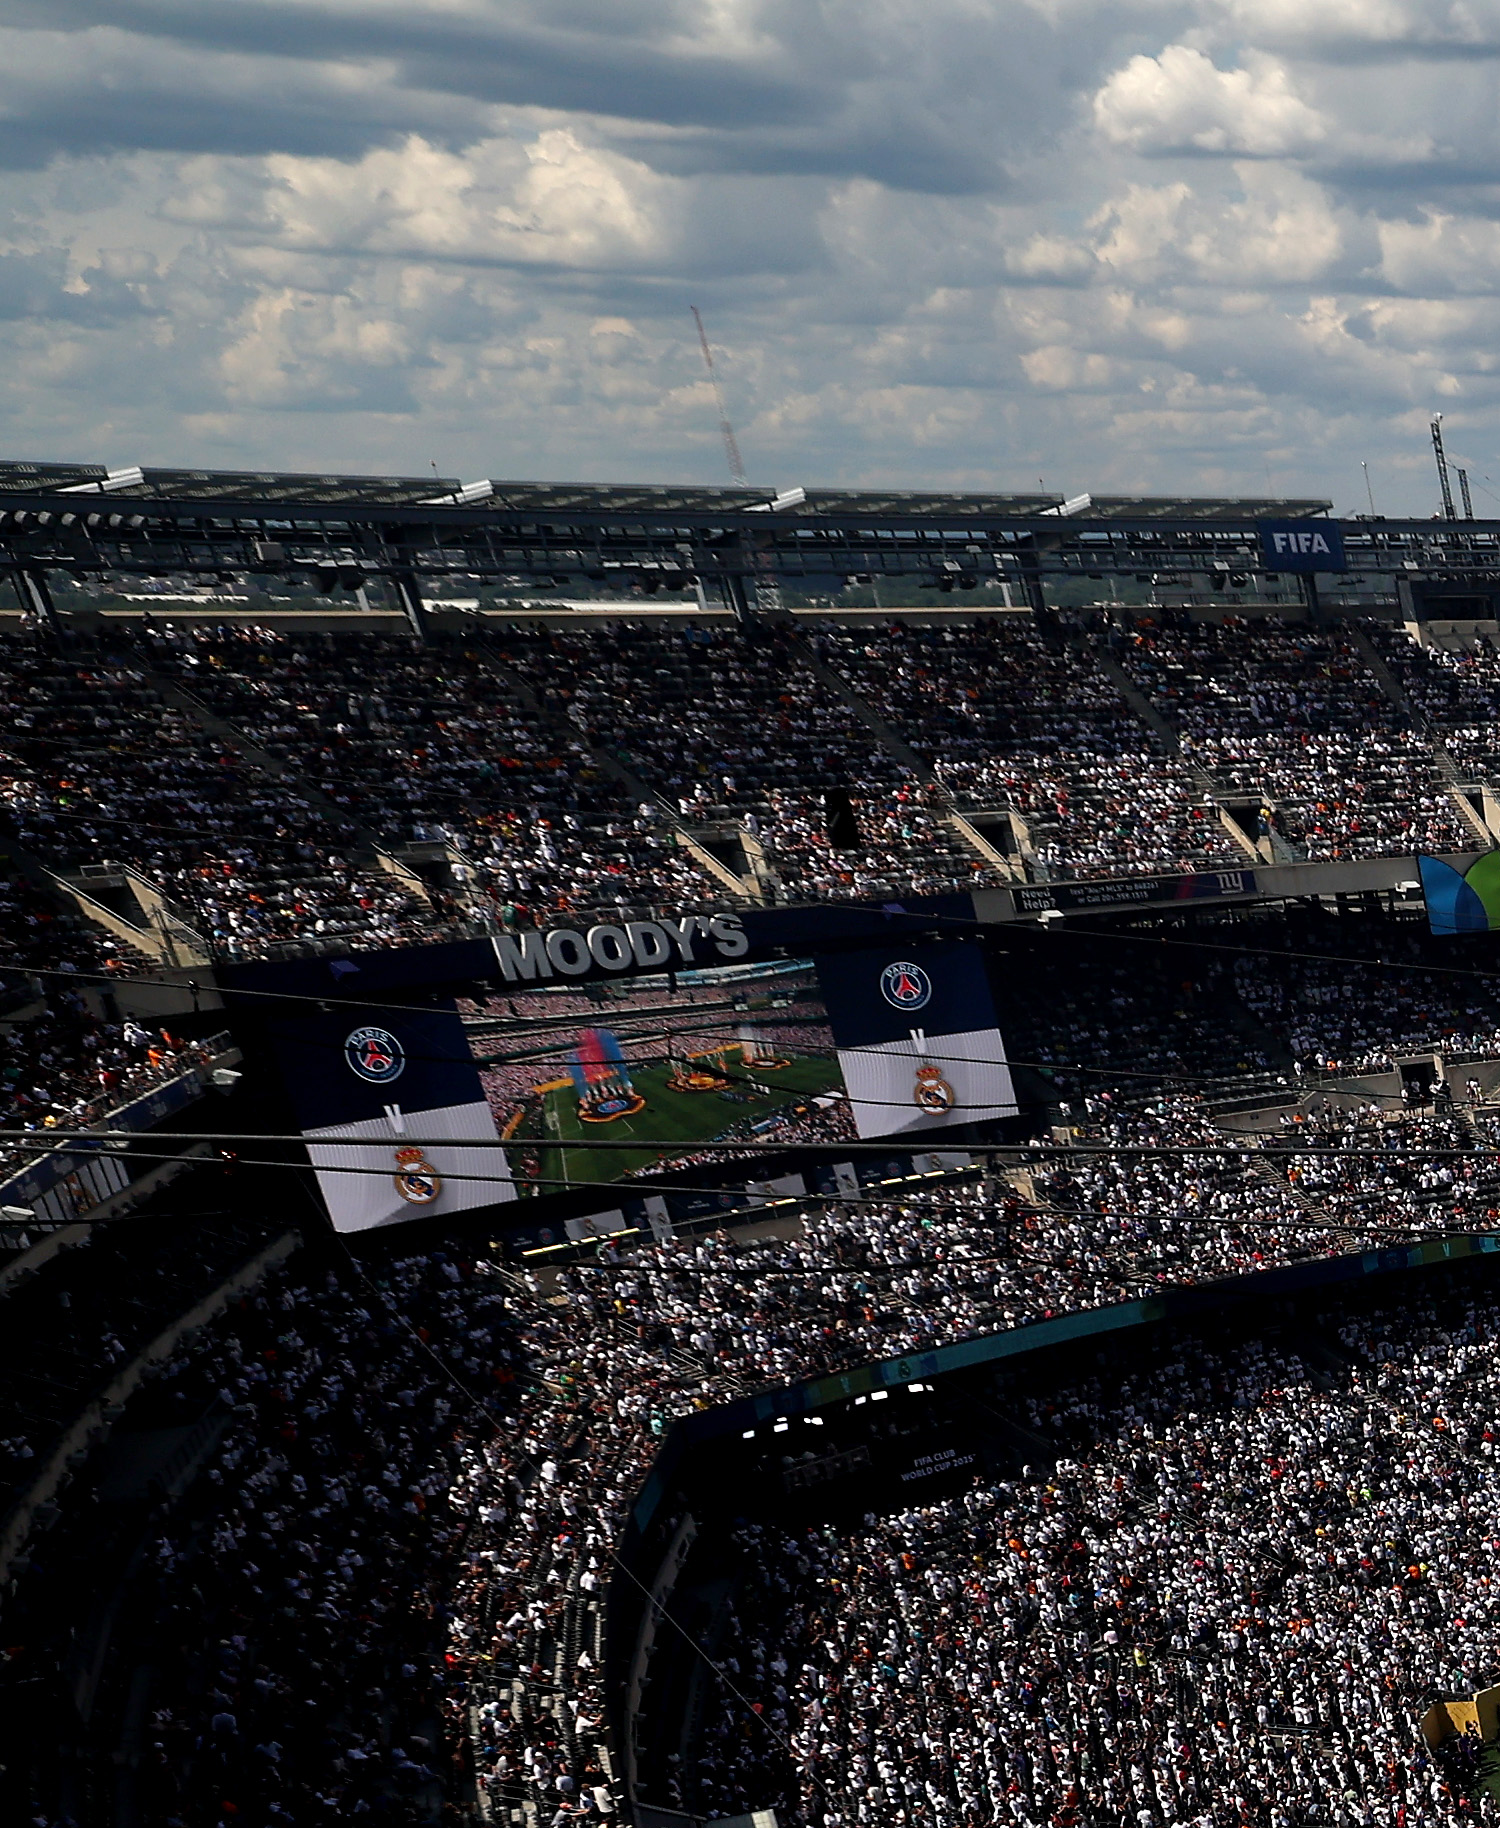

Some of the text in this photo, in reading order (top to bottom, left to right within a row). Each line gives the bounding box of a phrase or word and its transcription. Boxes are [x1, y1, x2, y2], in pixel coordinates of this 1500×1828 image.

[1272, 532, 1331, 555] FIFA
[1021, 888, 1051, 900] Need
[1023, 898, 1056, 911] Help?
[491, 912, 750, 982] MOODY'S
